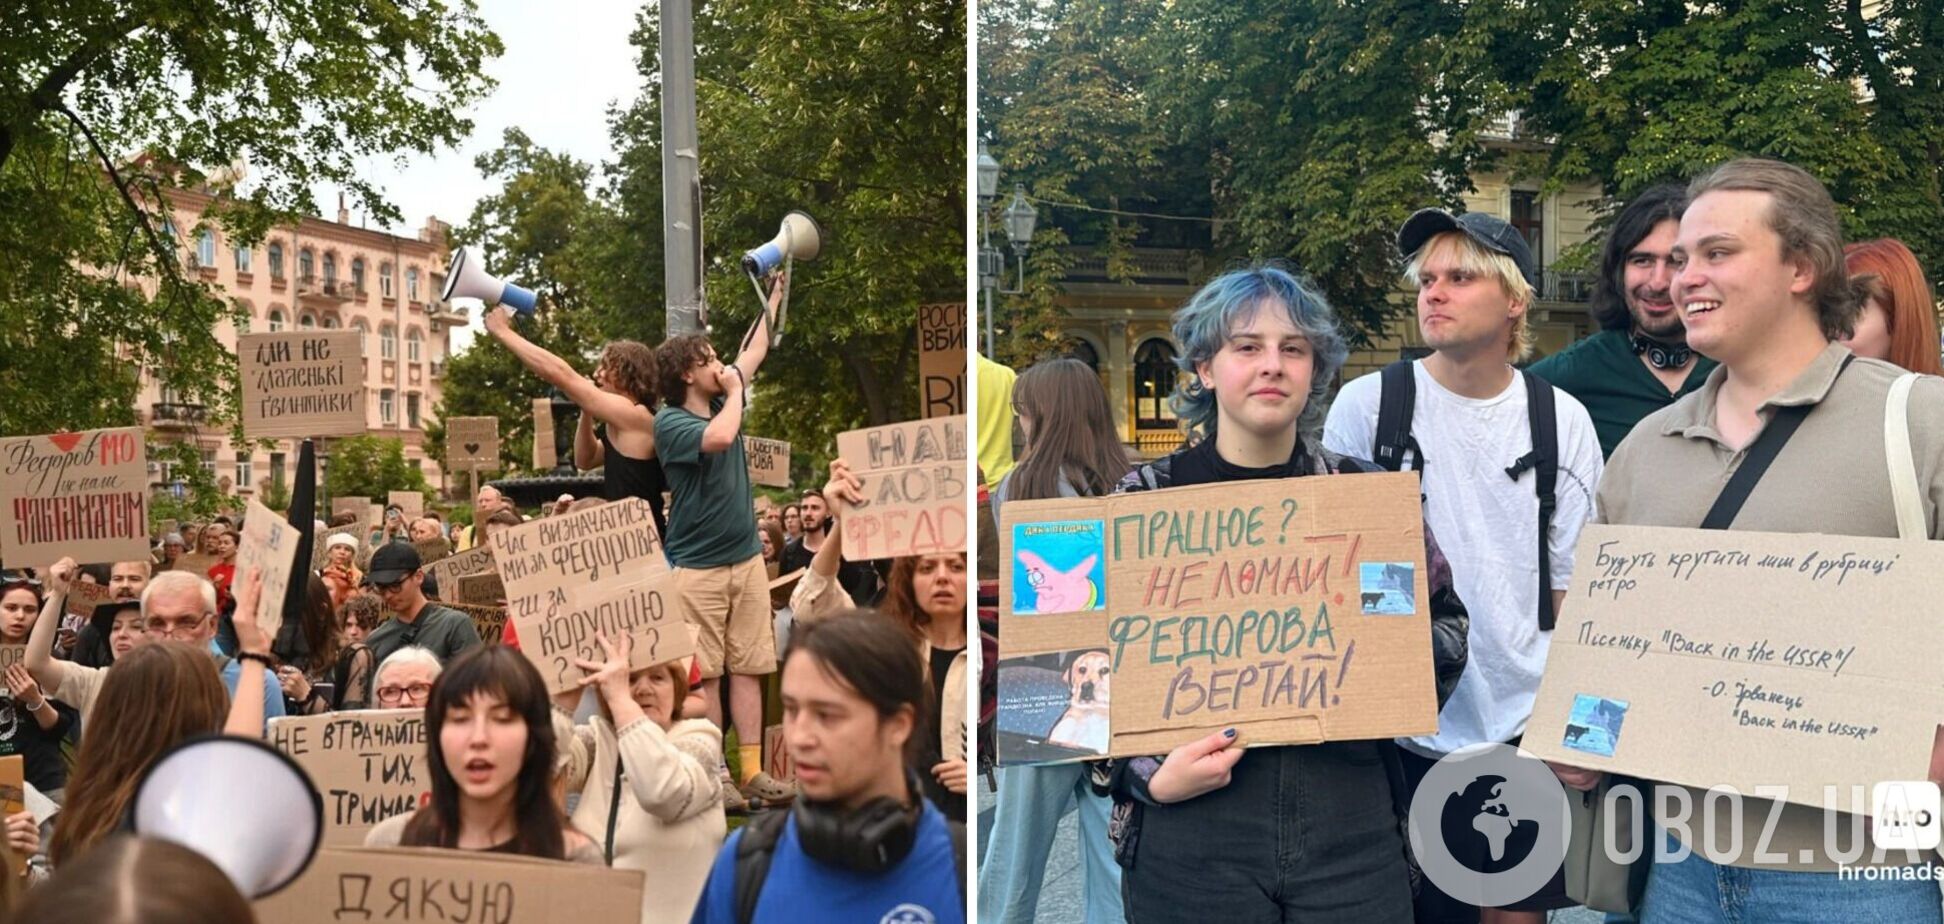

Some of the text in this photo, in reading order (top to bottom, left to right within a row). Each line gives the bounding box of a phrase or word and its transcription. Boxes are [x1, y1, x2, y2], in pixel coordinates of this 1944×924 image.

[923, 327, 967, 352] ВБИ
[100, 432, 136, 466] МО
[539, 499, 652, 547] ВИЗНАЧАТИСЯ
[503, 557, 528, 583] МИ
[552, 525, 660, 581] ФЕДОРОВА
[1595, 540, 1656, 577] Будуть
[1667, 550, 1750, 581] крутити
[1799, 551, 1819, 572] в
[1143, 561, 1209, 609] НЕ
[1588, 578, 1637, 600] ретро
[1109, 601, 1337, 674] ФЕДОРОВА
[1577, 620, 1651, 659] Пісеньку
[1721, 642, 1740, 658] in
[1747, 639, 1775, 662] the
[275, 716, 427, 755] НЕ ВТРАЧАЙТЕ
[1781, 719, 1798, 731] in
[1798, 718, 1823, 735] the
[331, 873, 515, 924] ДЯКУЮ
